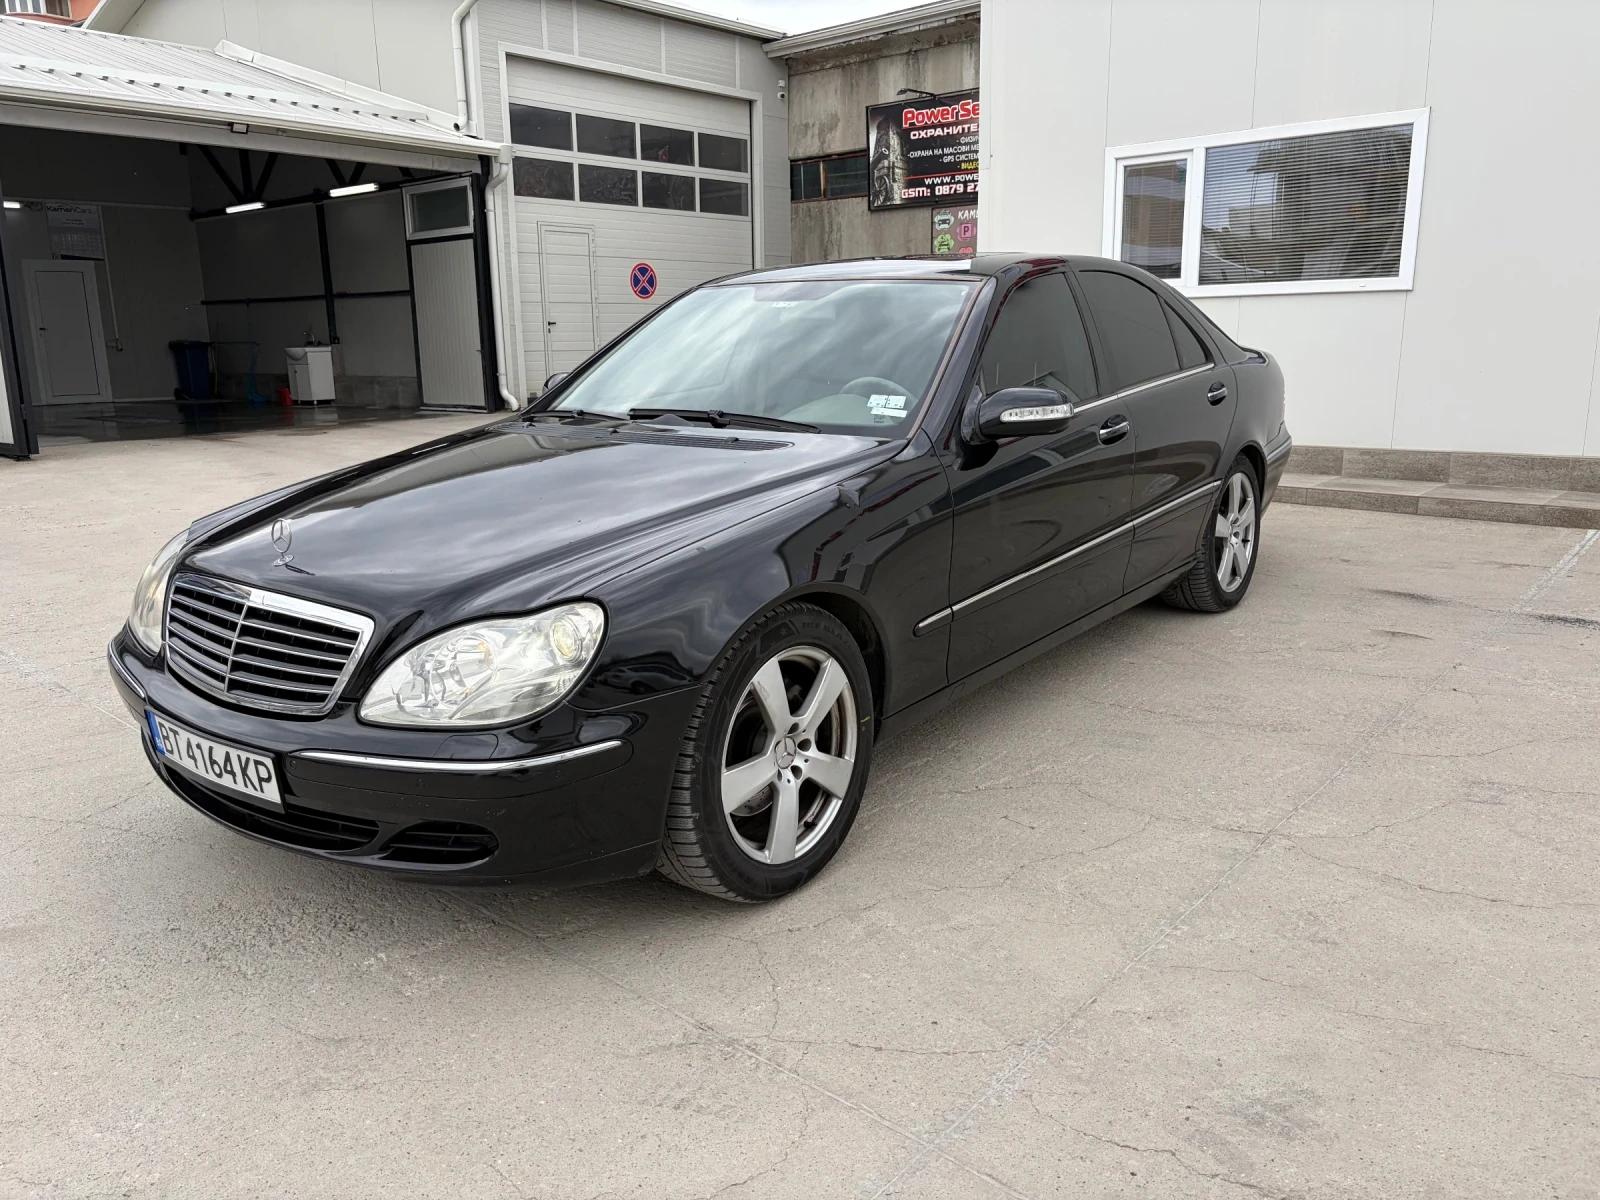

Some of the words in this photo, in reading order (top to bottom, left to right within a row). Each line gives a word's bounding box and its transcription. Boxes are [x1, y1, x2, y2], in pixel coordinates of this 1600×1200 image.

[910, 123, 979, 139] ОХРАНИТЕ
[934, 147, 942, 155] НА
[944, 145, 970, 154] МАСОВИ
[943, 155, 954, 163] GPS
[902, 187, 930, 198] GSM:
[935, 183, 963, 195] 0879
[46, 205, 92, 213] KamenCars
